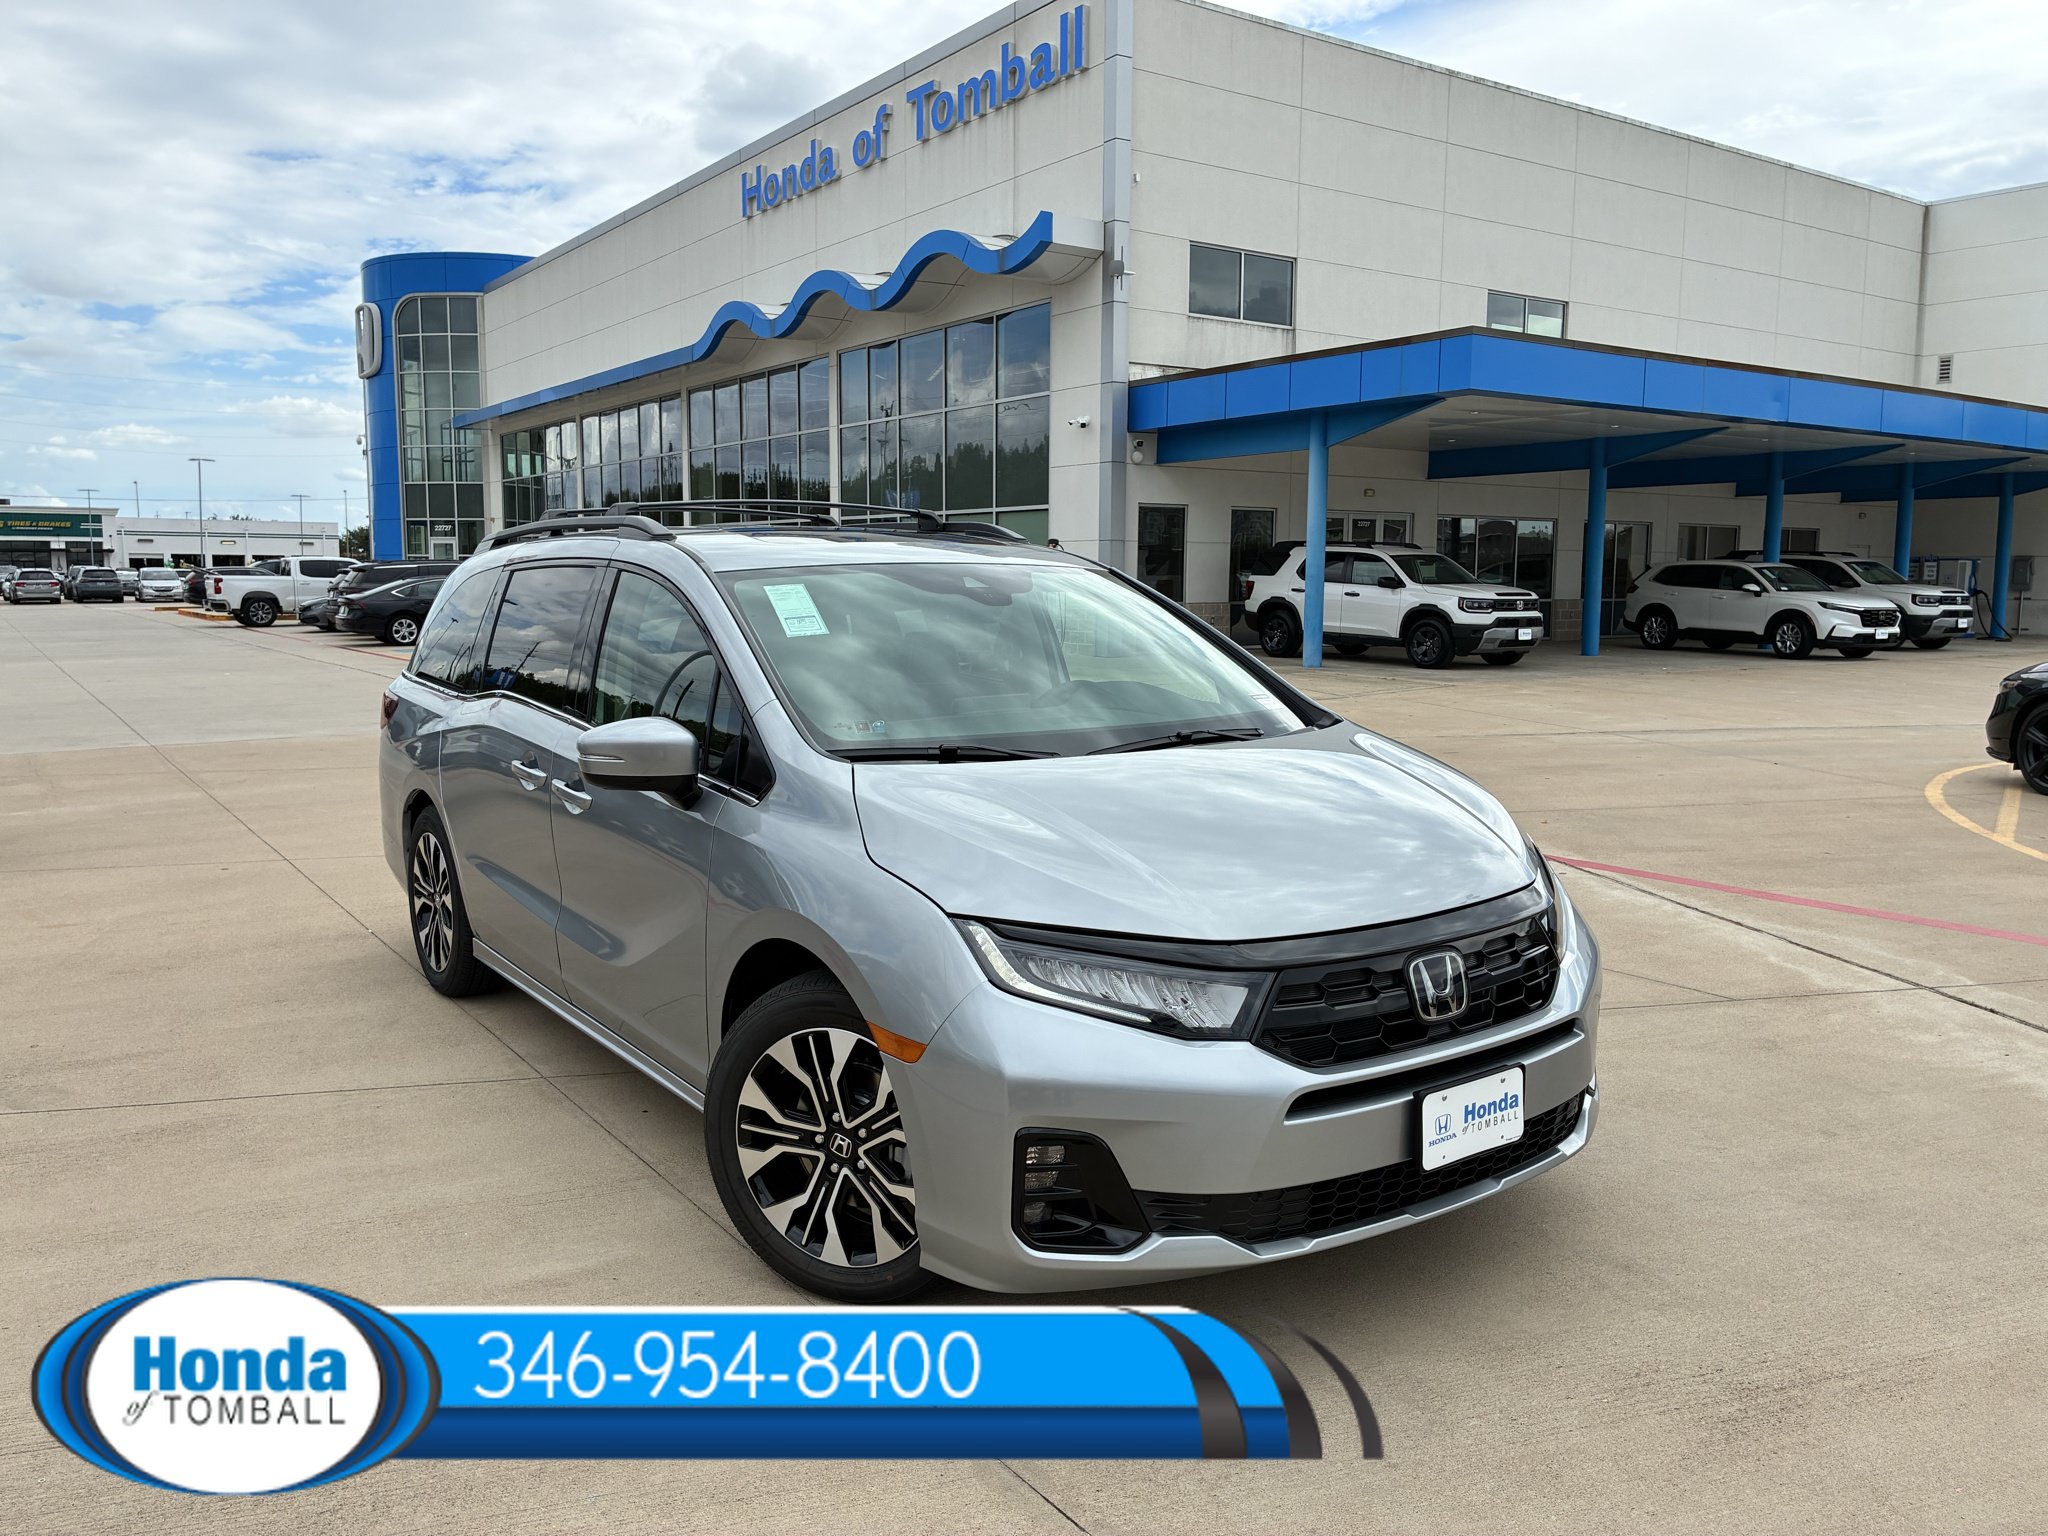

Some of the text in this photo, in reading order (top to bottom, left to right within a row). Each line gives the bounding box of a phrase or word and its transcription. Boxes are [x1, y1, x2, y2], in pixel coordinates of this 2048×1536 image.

[741, 4, 1090, 218] Honda of Tomball
[1463, 1091, 1520, 1124] Honda
[1461, 1110, 1519, 1136] of TOMBALL
[1428, 1132, 1458, 1148] HONDA
